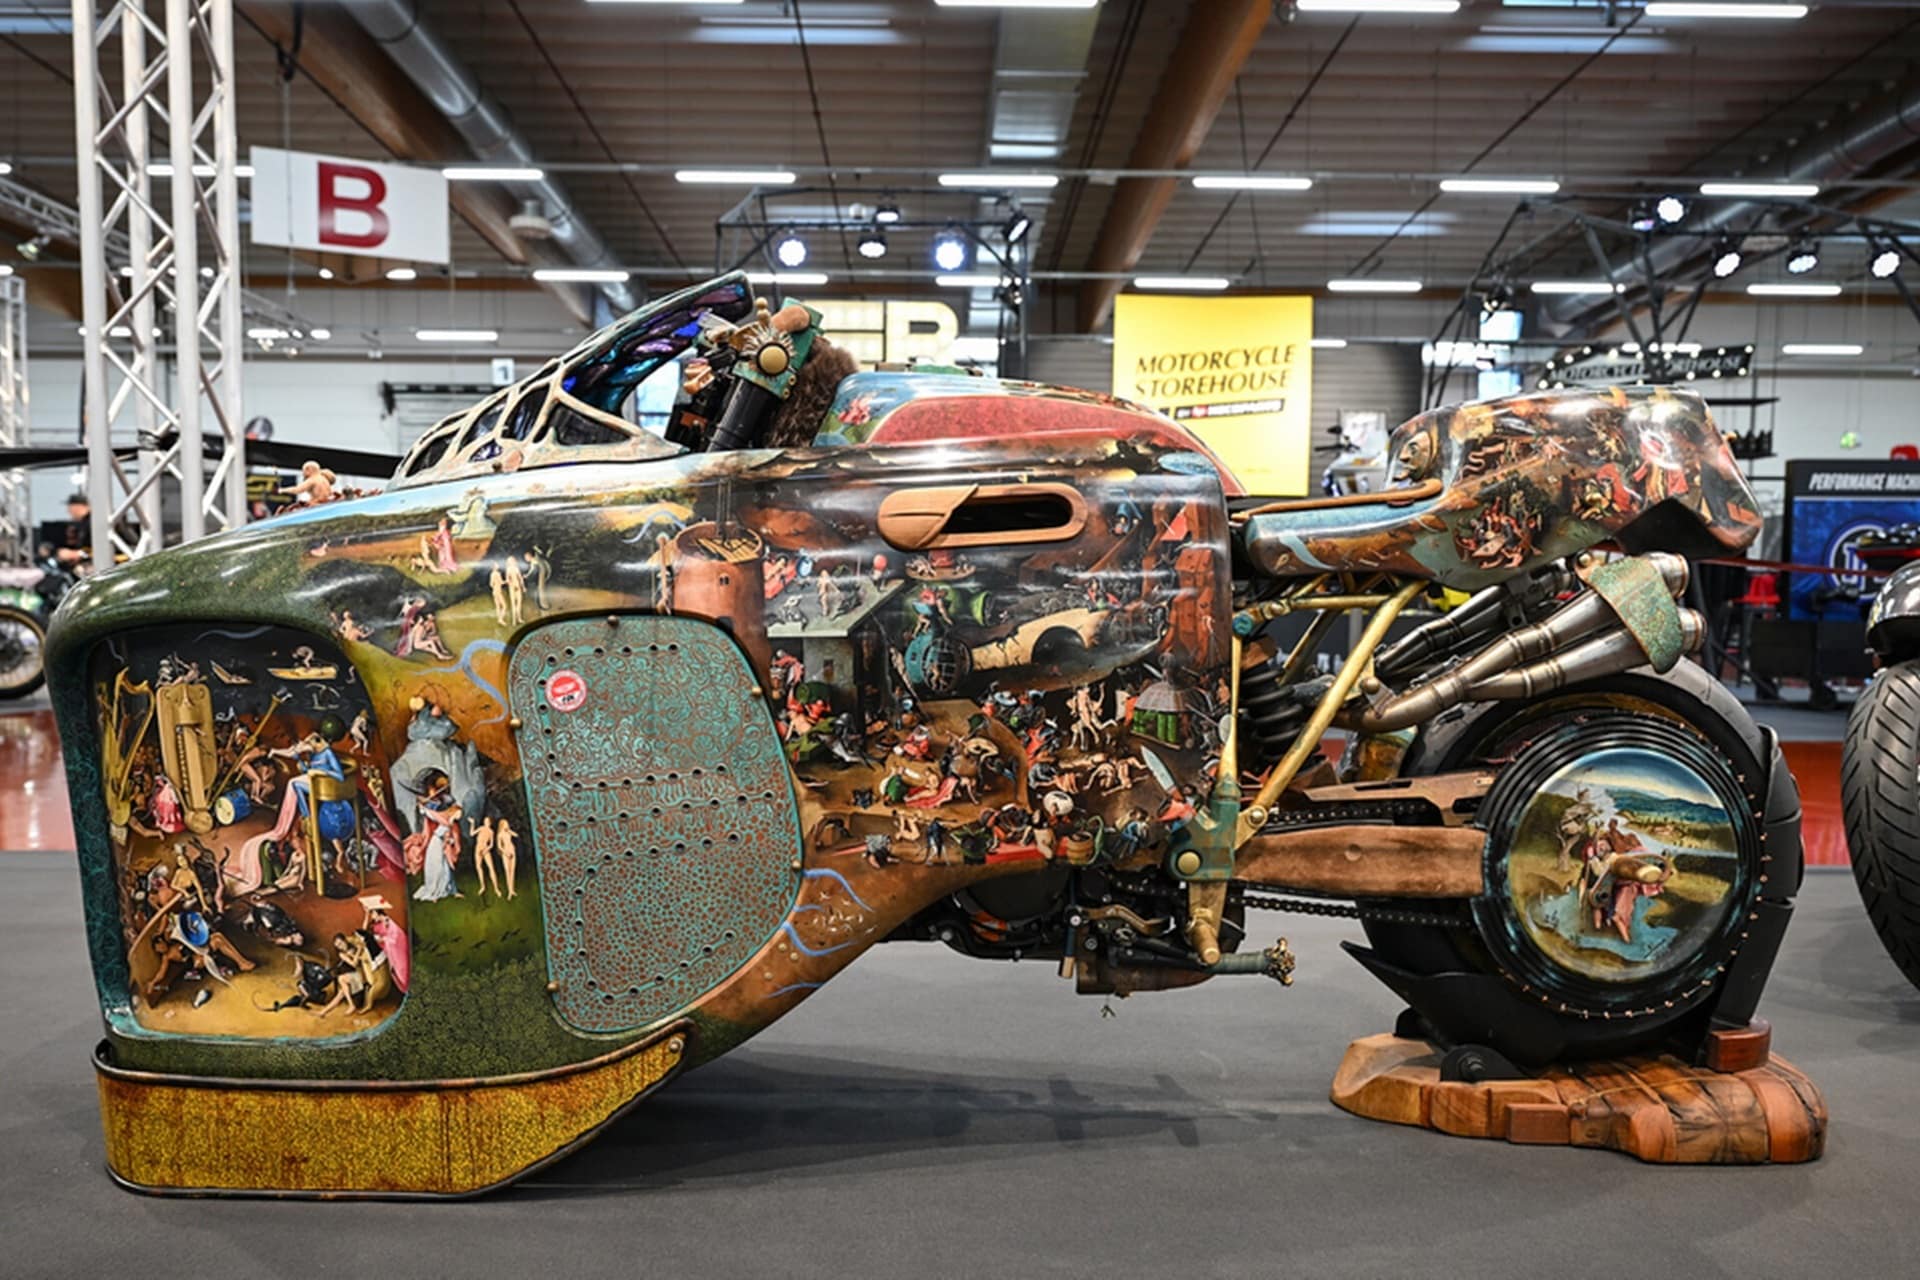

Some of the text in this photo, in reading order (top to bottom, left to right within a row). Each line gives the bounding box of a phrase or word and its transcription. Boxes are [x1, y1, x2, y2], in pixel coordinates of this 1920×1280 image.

[318, 161, 390, 248] B
[1136, 344, 1296, 374] MOTORCYCLE
[1136, 369, 1290, 397] STOREHOUSE
[1809, 472, 1886, 490] PERFORMANCE
